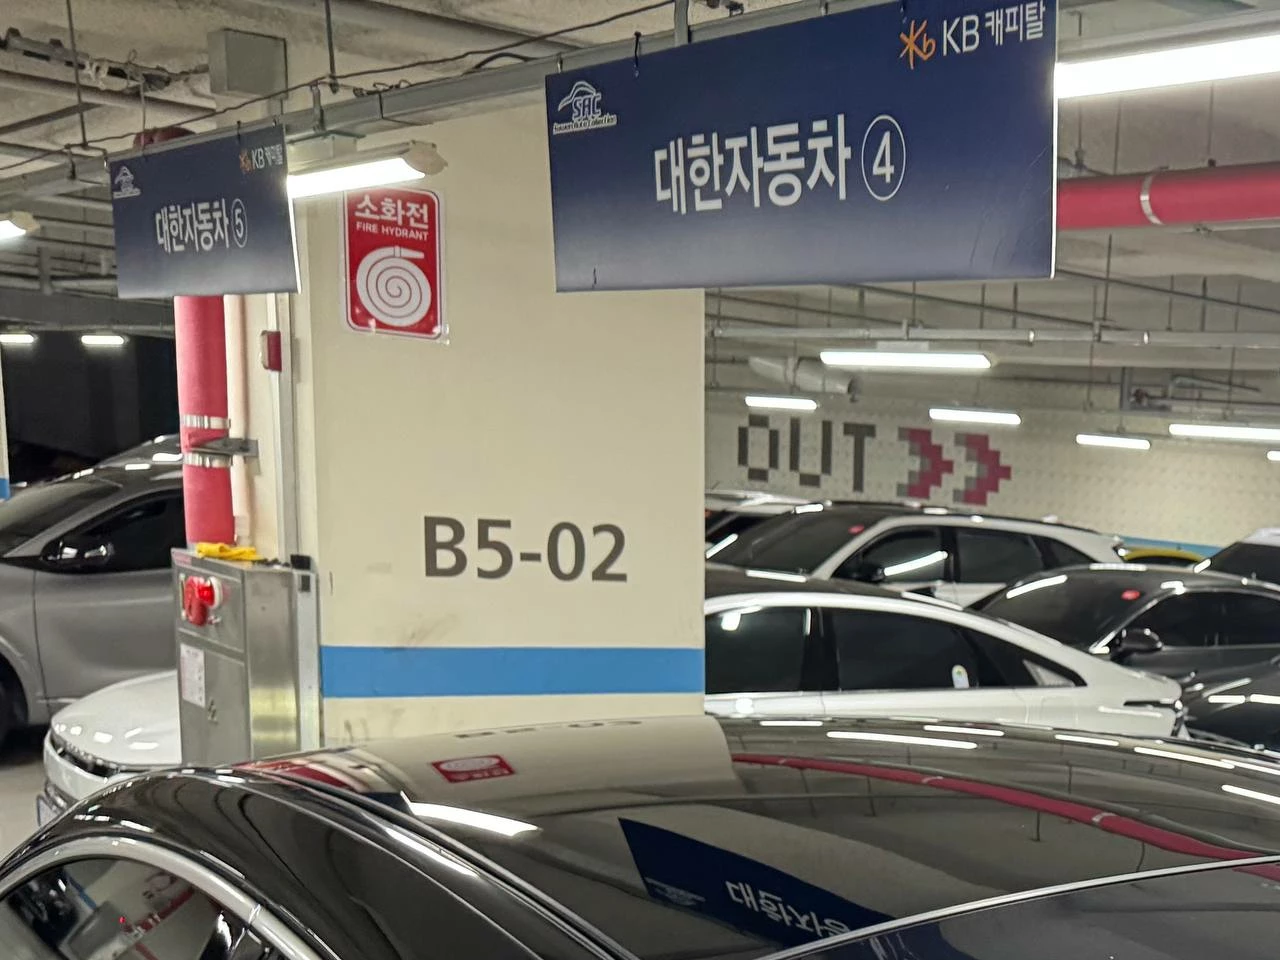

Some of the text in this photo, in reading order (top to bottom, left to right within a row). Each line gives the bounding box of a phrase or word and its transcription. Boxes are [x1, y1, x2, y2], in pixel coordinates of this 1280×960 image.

[943, 1, 1045, 56] KB 캐피탈
[654, 113, 851, 215] 대한자동차
[155, 198, 229, 253] 대한자동차
[354, 194, 428, 229] 소화전
[356, 221, 428, 241] FIRE HYDRANT
[738, 414, 876, 493] OUT
[424, 516, 627, 582] B5-02
